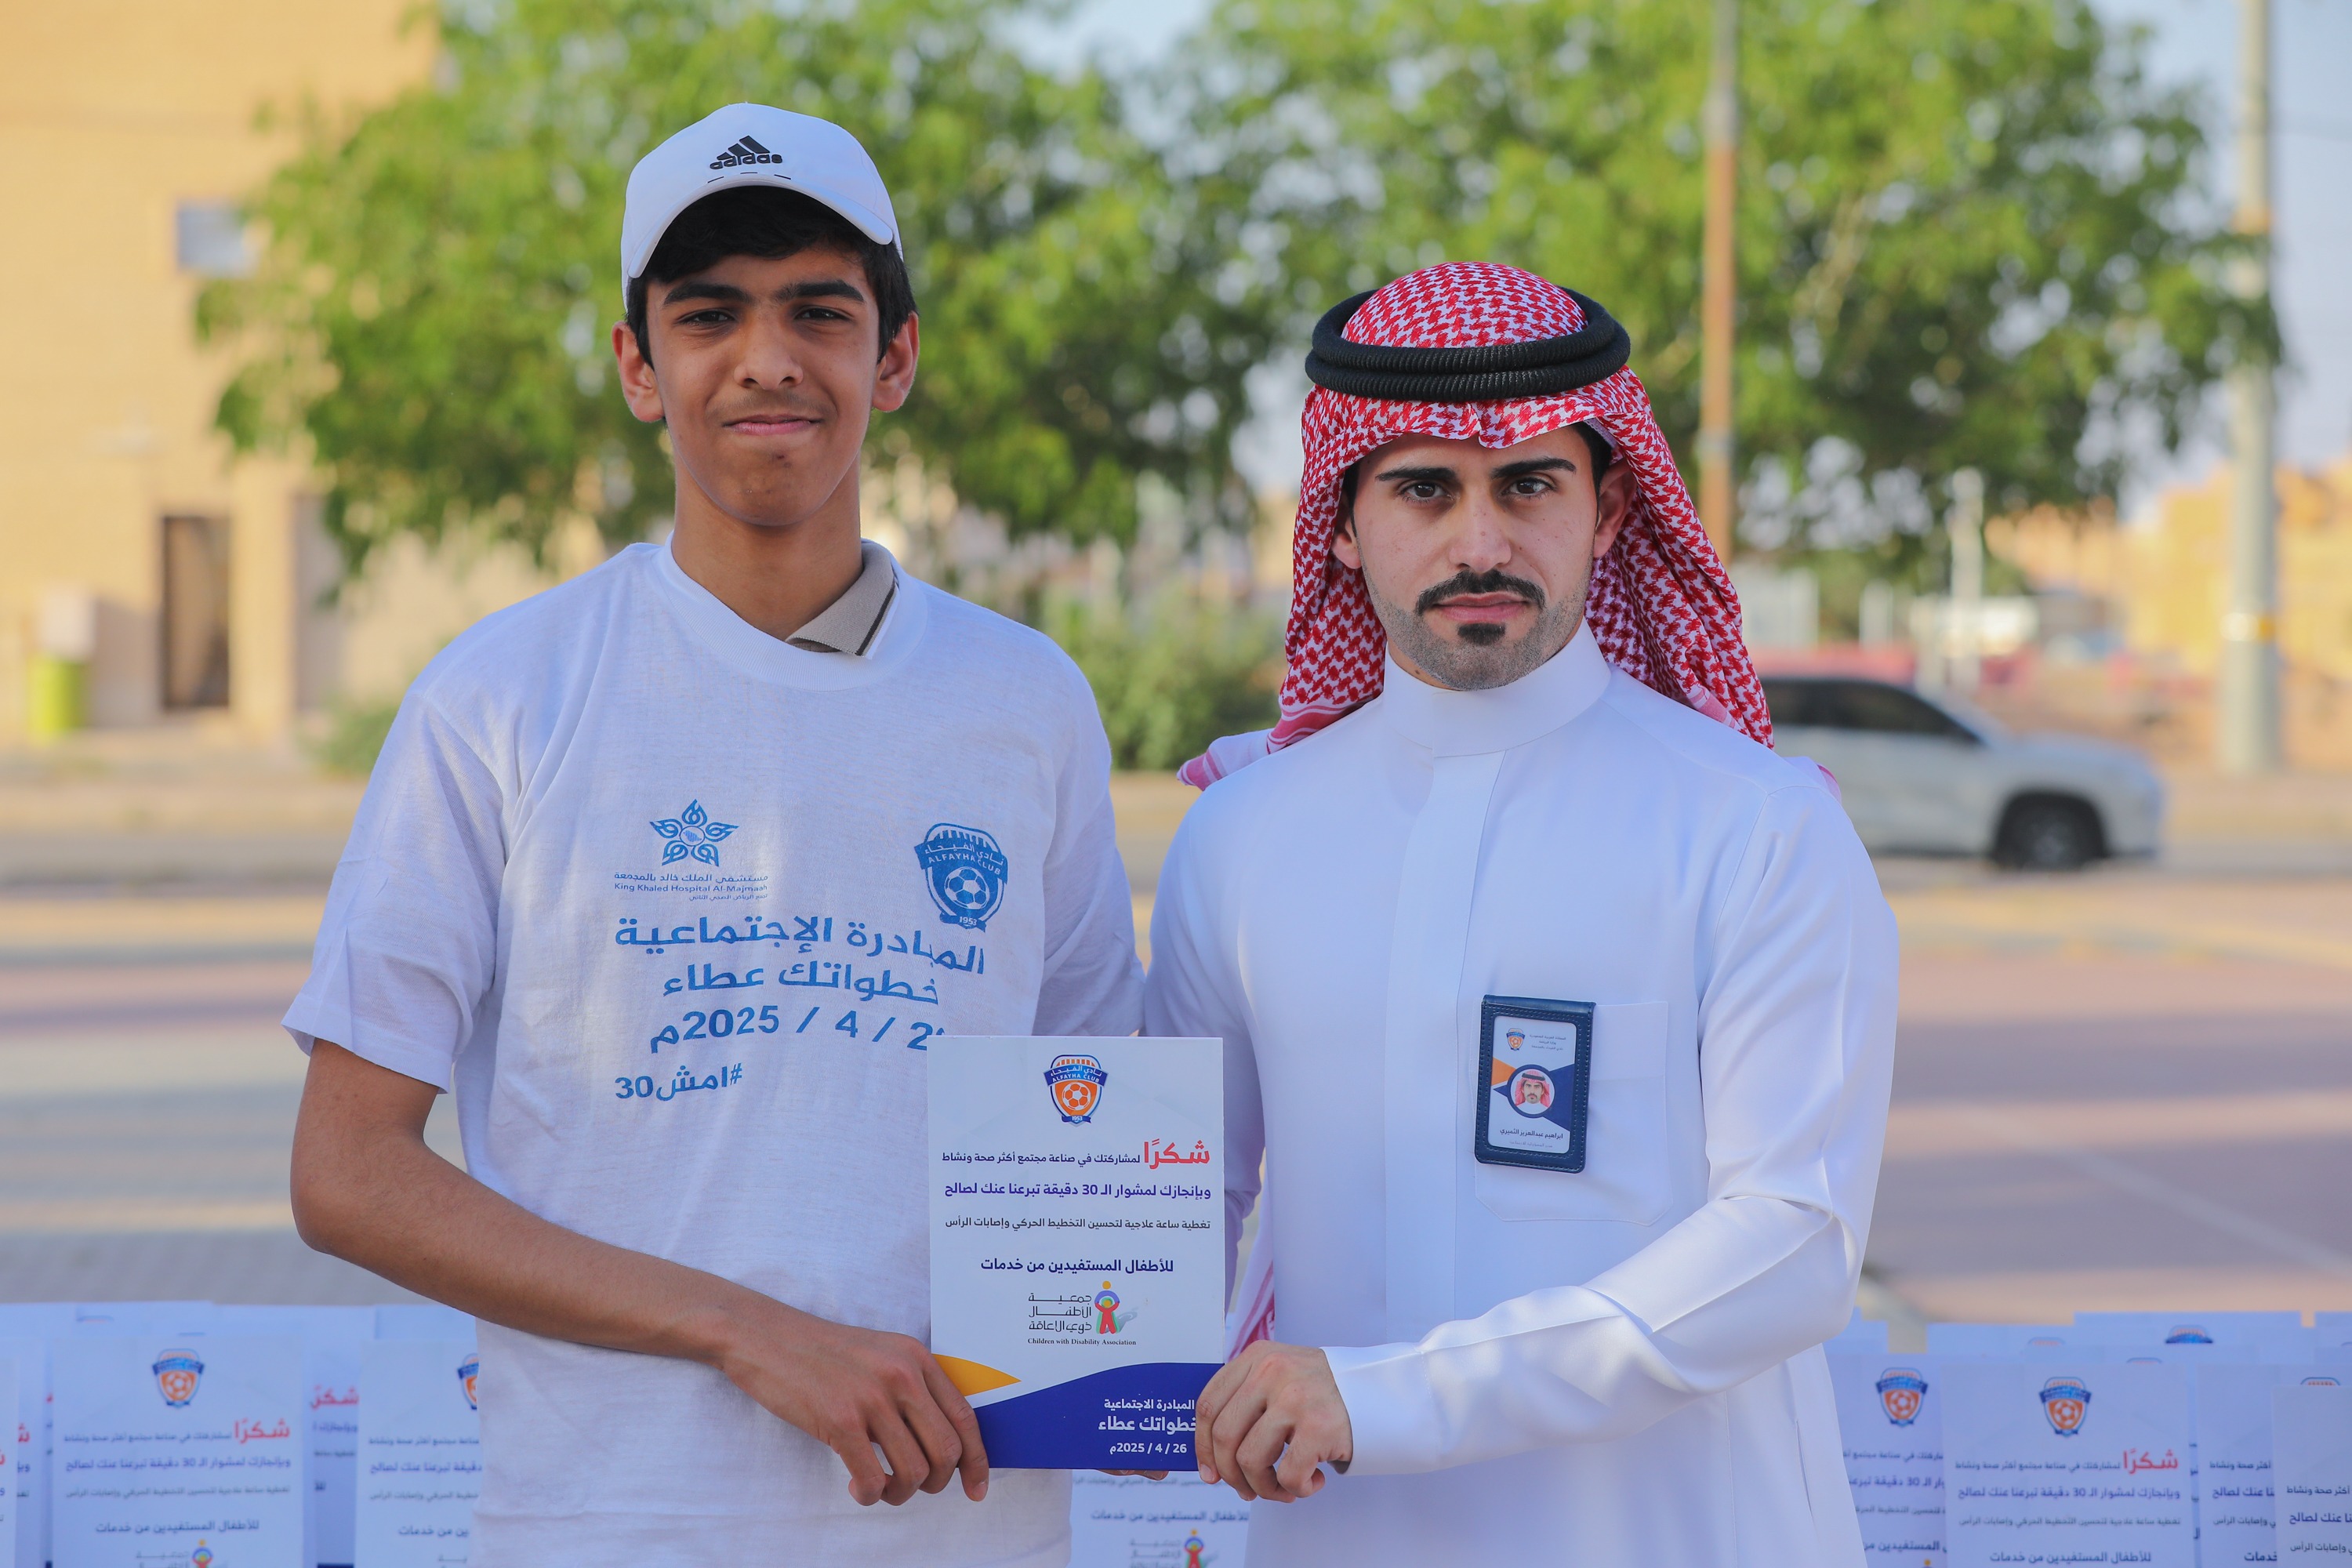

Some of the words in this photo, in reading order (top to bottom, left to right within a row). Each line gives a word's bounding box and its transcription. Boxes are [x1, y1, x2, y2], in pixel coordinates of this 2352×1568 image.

[710, 153, 782, 169] adidas
[928, 853, 975, 863] ALFAYHA
[978, 859, 1000, 875] CLUB
[659, 873, 678, 882] خالد
[681, 873, 713, 882] الملك
[614, 883, 635, 892] King
[637, 884, 669, 892] Khaled
[671, 884, 710, 893] Hospital
[713, 884, 768, 893] Al-Majmaah
[959, 916, 977, 925] 1953
[615, 916, 833, 954] الإجتماعية
[847, 921, 985, 975] المبادرة
[662, 964, 764, 997] عطاء
[778, 960, 939, 1005] خطواتك
[796, 1007, 820, 1033] /
[835, 1011, 858, 1038] 4
[650, 1005, 780, 1054] 2025م
[872, 1017, 896, 1044] /
[907, 1022, 947, 1051] 2
[1052, 1073, 1081, 1083] ALFAYHA
[1083, 1074, 1100, 1083] CLUB
[942, 1152, 971, 1163] ونشاط
[975, 1152, 995, 1162] صحة
[997, 1151, 1015, 1164] أكثر
[1018, 1152, 1047, 1165] مجتمع
[1049, 1152, 1075, 1162] صناعة
[1078, 1152, 1091, 1167] في
[1094, 1152, 1140, 1164] لمشاركتك
[1144, 1138, 1210, 1169] شكرًا
[945, 1182, 977, 1197] لصالح
[981, 1182, 1005, 1195] عنك
[1008, 1183, 1040, 1197] تبرعنا
[1044, 1183, 1078, 1198] دقيقة
[1082, 1185, 1098, 1196] 30
[1115, 1184, 1156, 1198] لمشوار
[1160, 1184, 1211, 1200] وبإنجازك
[946, 1215, 971, 1228] الرأس
[974, 1217, 1010, 1229] وإصابات
[1012, 1218, 1044, 1232] الحركي
[1048, 1218, 1085, 1229] التخطيط
[1088, 1218, 1122, 1231] لتحسين
[1125, 1218, 1153, 1231] علاجية
[1156, 1219, 1179, 1229] ساعة
[1182, 1220, 1210, 1231] تغطية
[981, 1258, 1023, 1271] خدمات
[1027, 1260, 1044, 1272] من
[1049, 1259, 1121, 1274] المستفيدين
[1125, 1259, 1174, 1274] للأطفال
[1066, 1322, 1091, 1334] ذوي
[1104, 1398, 1154, 1410] الاجتماعية
[1156, 1399, 1195, 1411] المبادرة
[1098, 1415, 1135, 1431] عطاء
[234, 1417, 290, 1444] شكرًا
[1109, 1443, 1145, 1454] 2025م
[1147, 1443, 1153, 1454] /
[1155, 1443, 1163, 1453] 4
[1164, 1443, 1171, 1454] /
[1173, 1443, 1187, 1454] 26
[2123, 1448, 2178, 1475] شكرًا
[2073, 1487, 2086, 1497] 30
[2286, 1485, 2313, 1496] ونشاط
[2314, 1486, 2332, 1494] صحة
[2333, 1485, 2350, 1496] أكثر
[2289, 1512, 2318, 1524] لصالح
[2320, 1512, 2342, 1523] عنك
